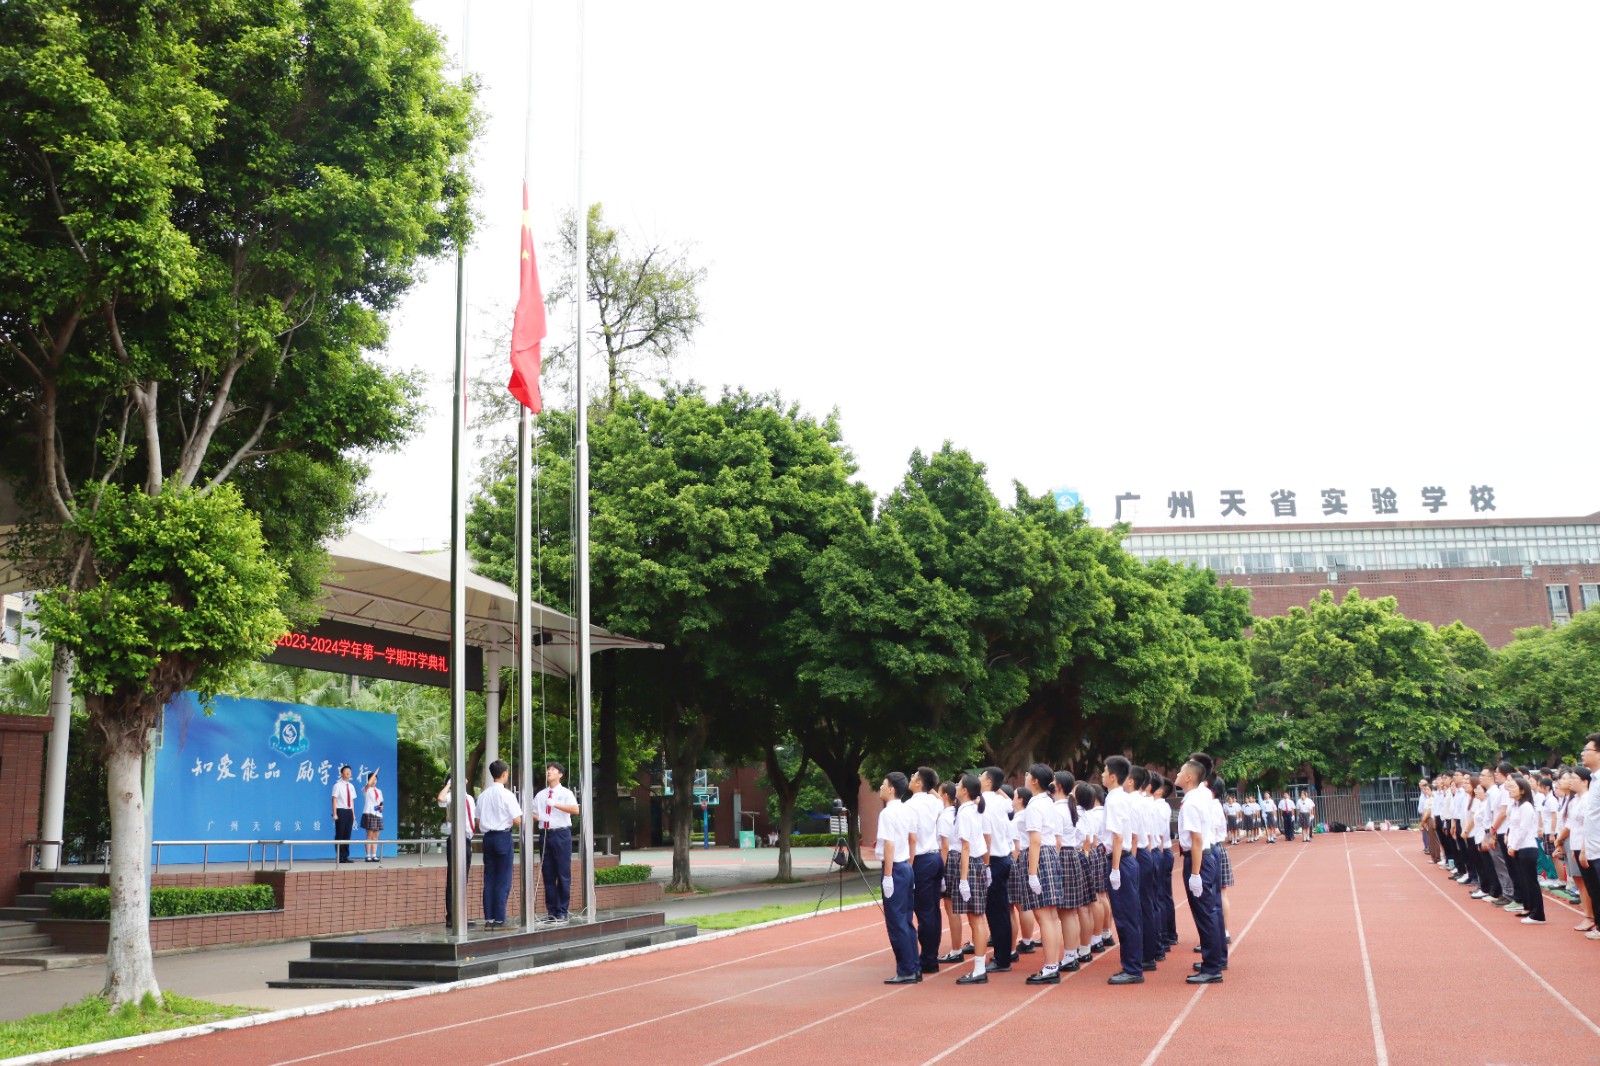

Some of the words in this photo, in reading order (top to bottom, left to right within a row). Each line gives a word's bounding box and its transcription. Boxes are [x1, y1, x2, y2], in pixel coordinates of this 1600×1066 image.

[1115, 485, 1497, 520] 广州天省实验学校
[273, 632, 448, 672] 2023-2024学年第一学期开学典礼
